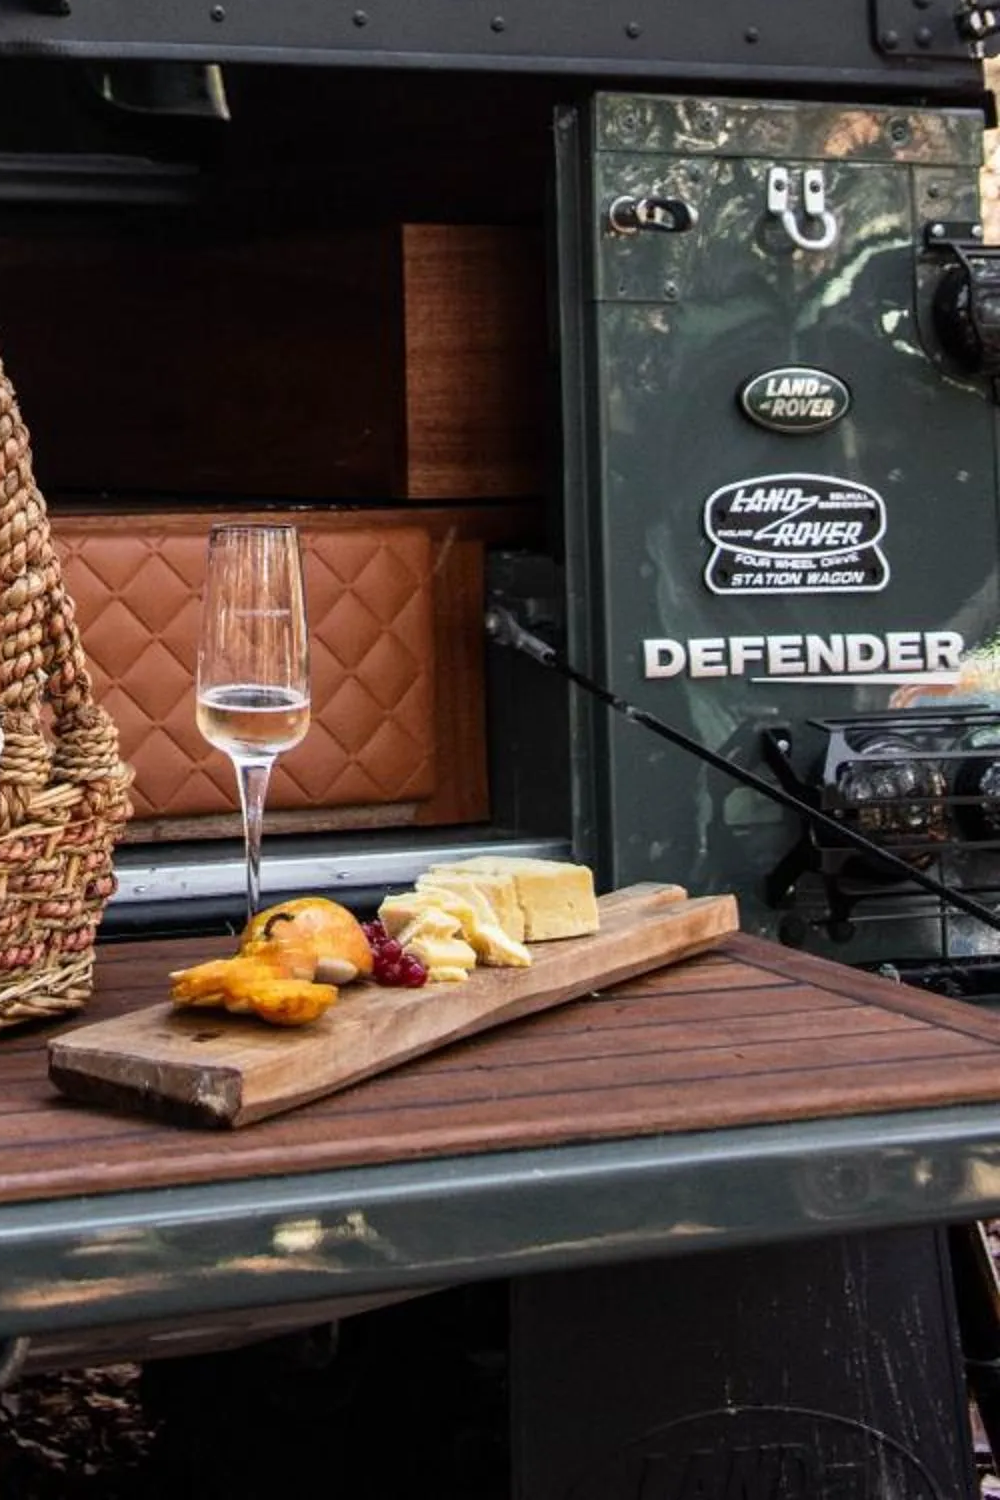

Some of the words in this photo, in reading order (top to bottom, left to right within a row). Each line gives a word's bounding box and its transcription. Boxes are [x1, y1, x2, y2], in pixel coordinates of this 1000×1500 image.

[766, 377, 821, 397] LAND
[770, 398, 836, 417] ROVER
[729, 487, 804, 512] LAND
[772, 520, 863, 546] ROVER
[733, 553, 772, 568] FOUR
[774, 557, 818, 569] WHEEL
[731, 571, 803, 587] STATION
[806, 570, 866, 586] WAGON
[643, 630, 965, 679] DEFENDER
